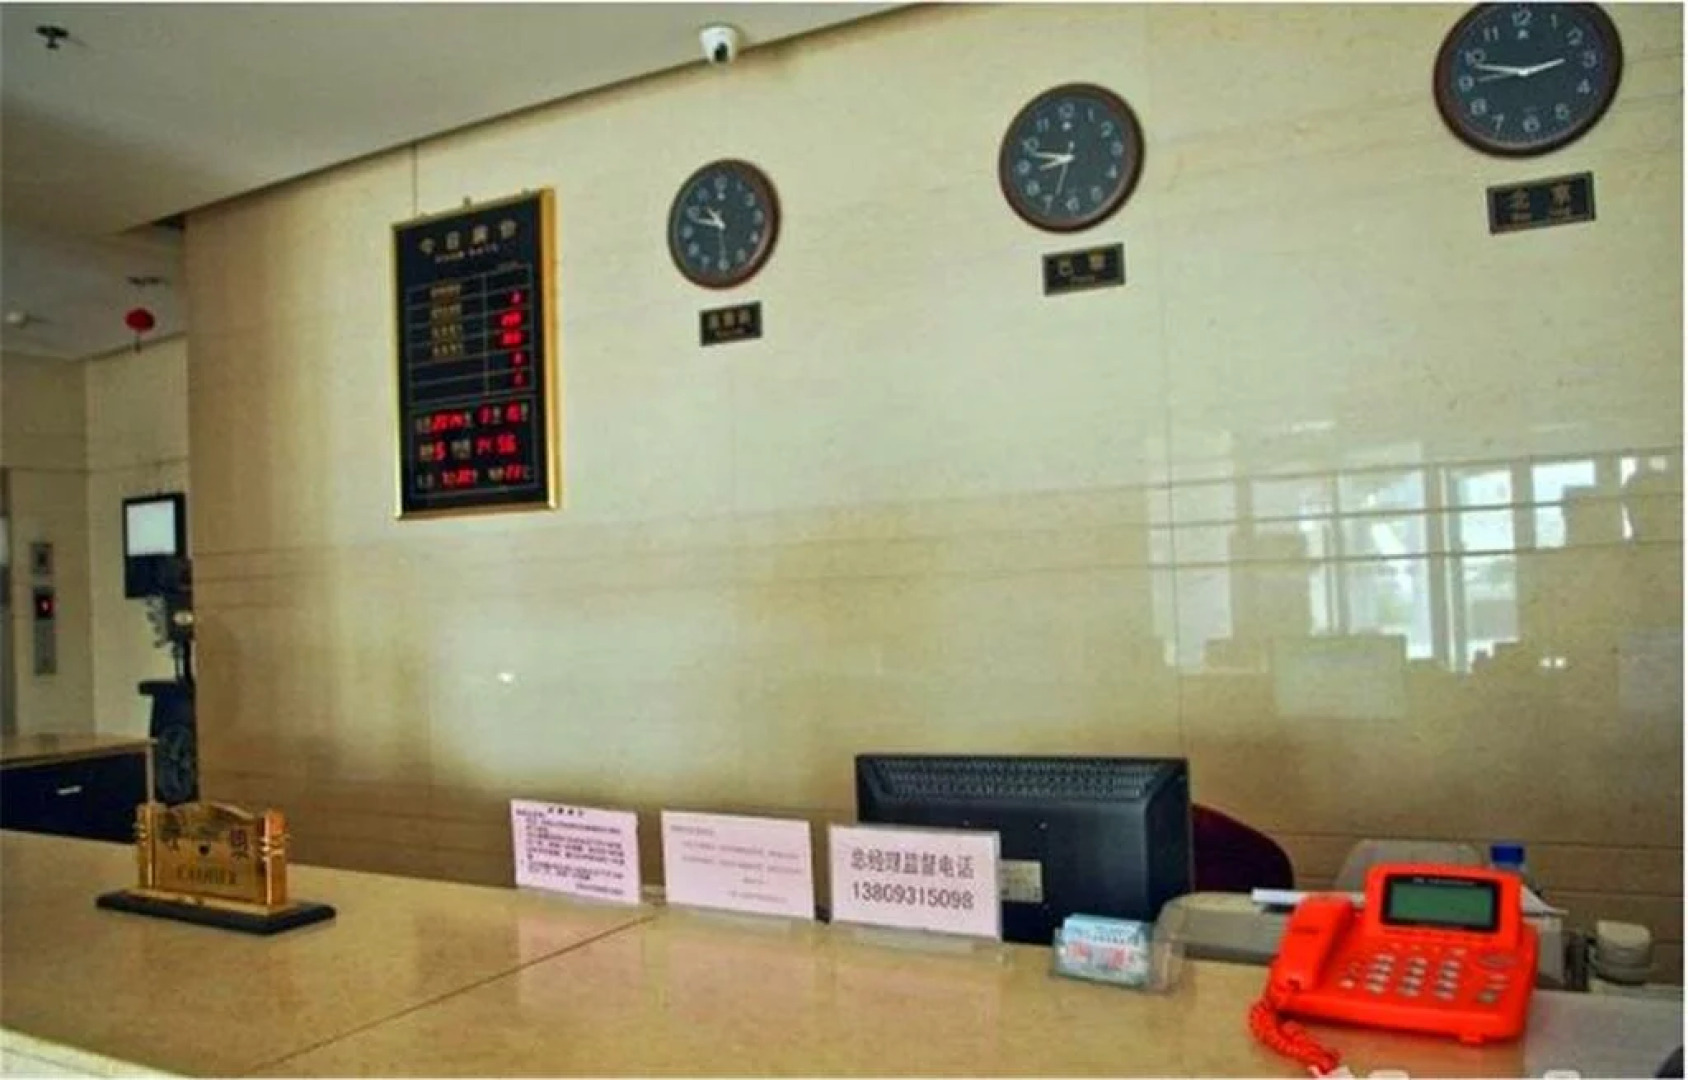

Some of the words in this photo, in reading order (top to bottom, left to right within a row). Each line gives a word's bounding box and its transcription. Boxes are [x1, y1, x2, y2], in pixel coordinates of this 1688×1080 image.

[1512, 10, 1532, 27] 12
[1483, 26, 1499, 42] 11
[1567, 27, 1584, 46] 2
[1465, 48, 1486, 65] 10
[1583, 51, 1597, 68] 3
[1458, 75, 1474, 92] 9
[1576, 79, 1591, 94] 4
[1471, 99, 1487, 115] 8
[1492, 114, 1504, 132] 7
[1523, 115, 1540, 132] 6
[850, 847, 975, 879] 总经理监督电话
[852, 880, 975, 910] 13809315098
